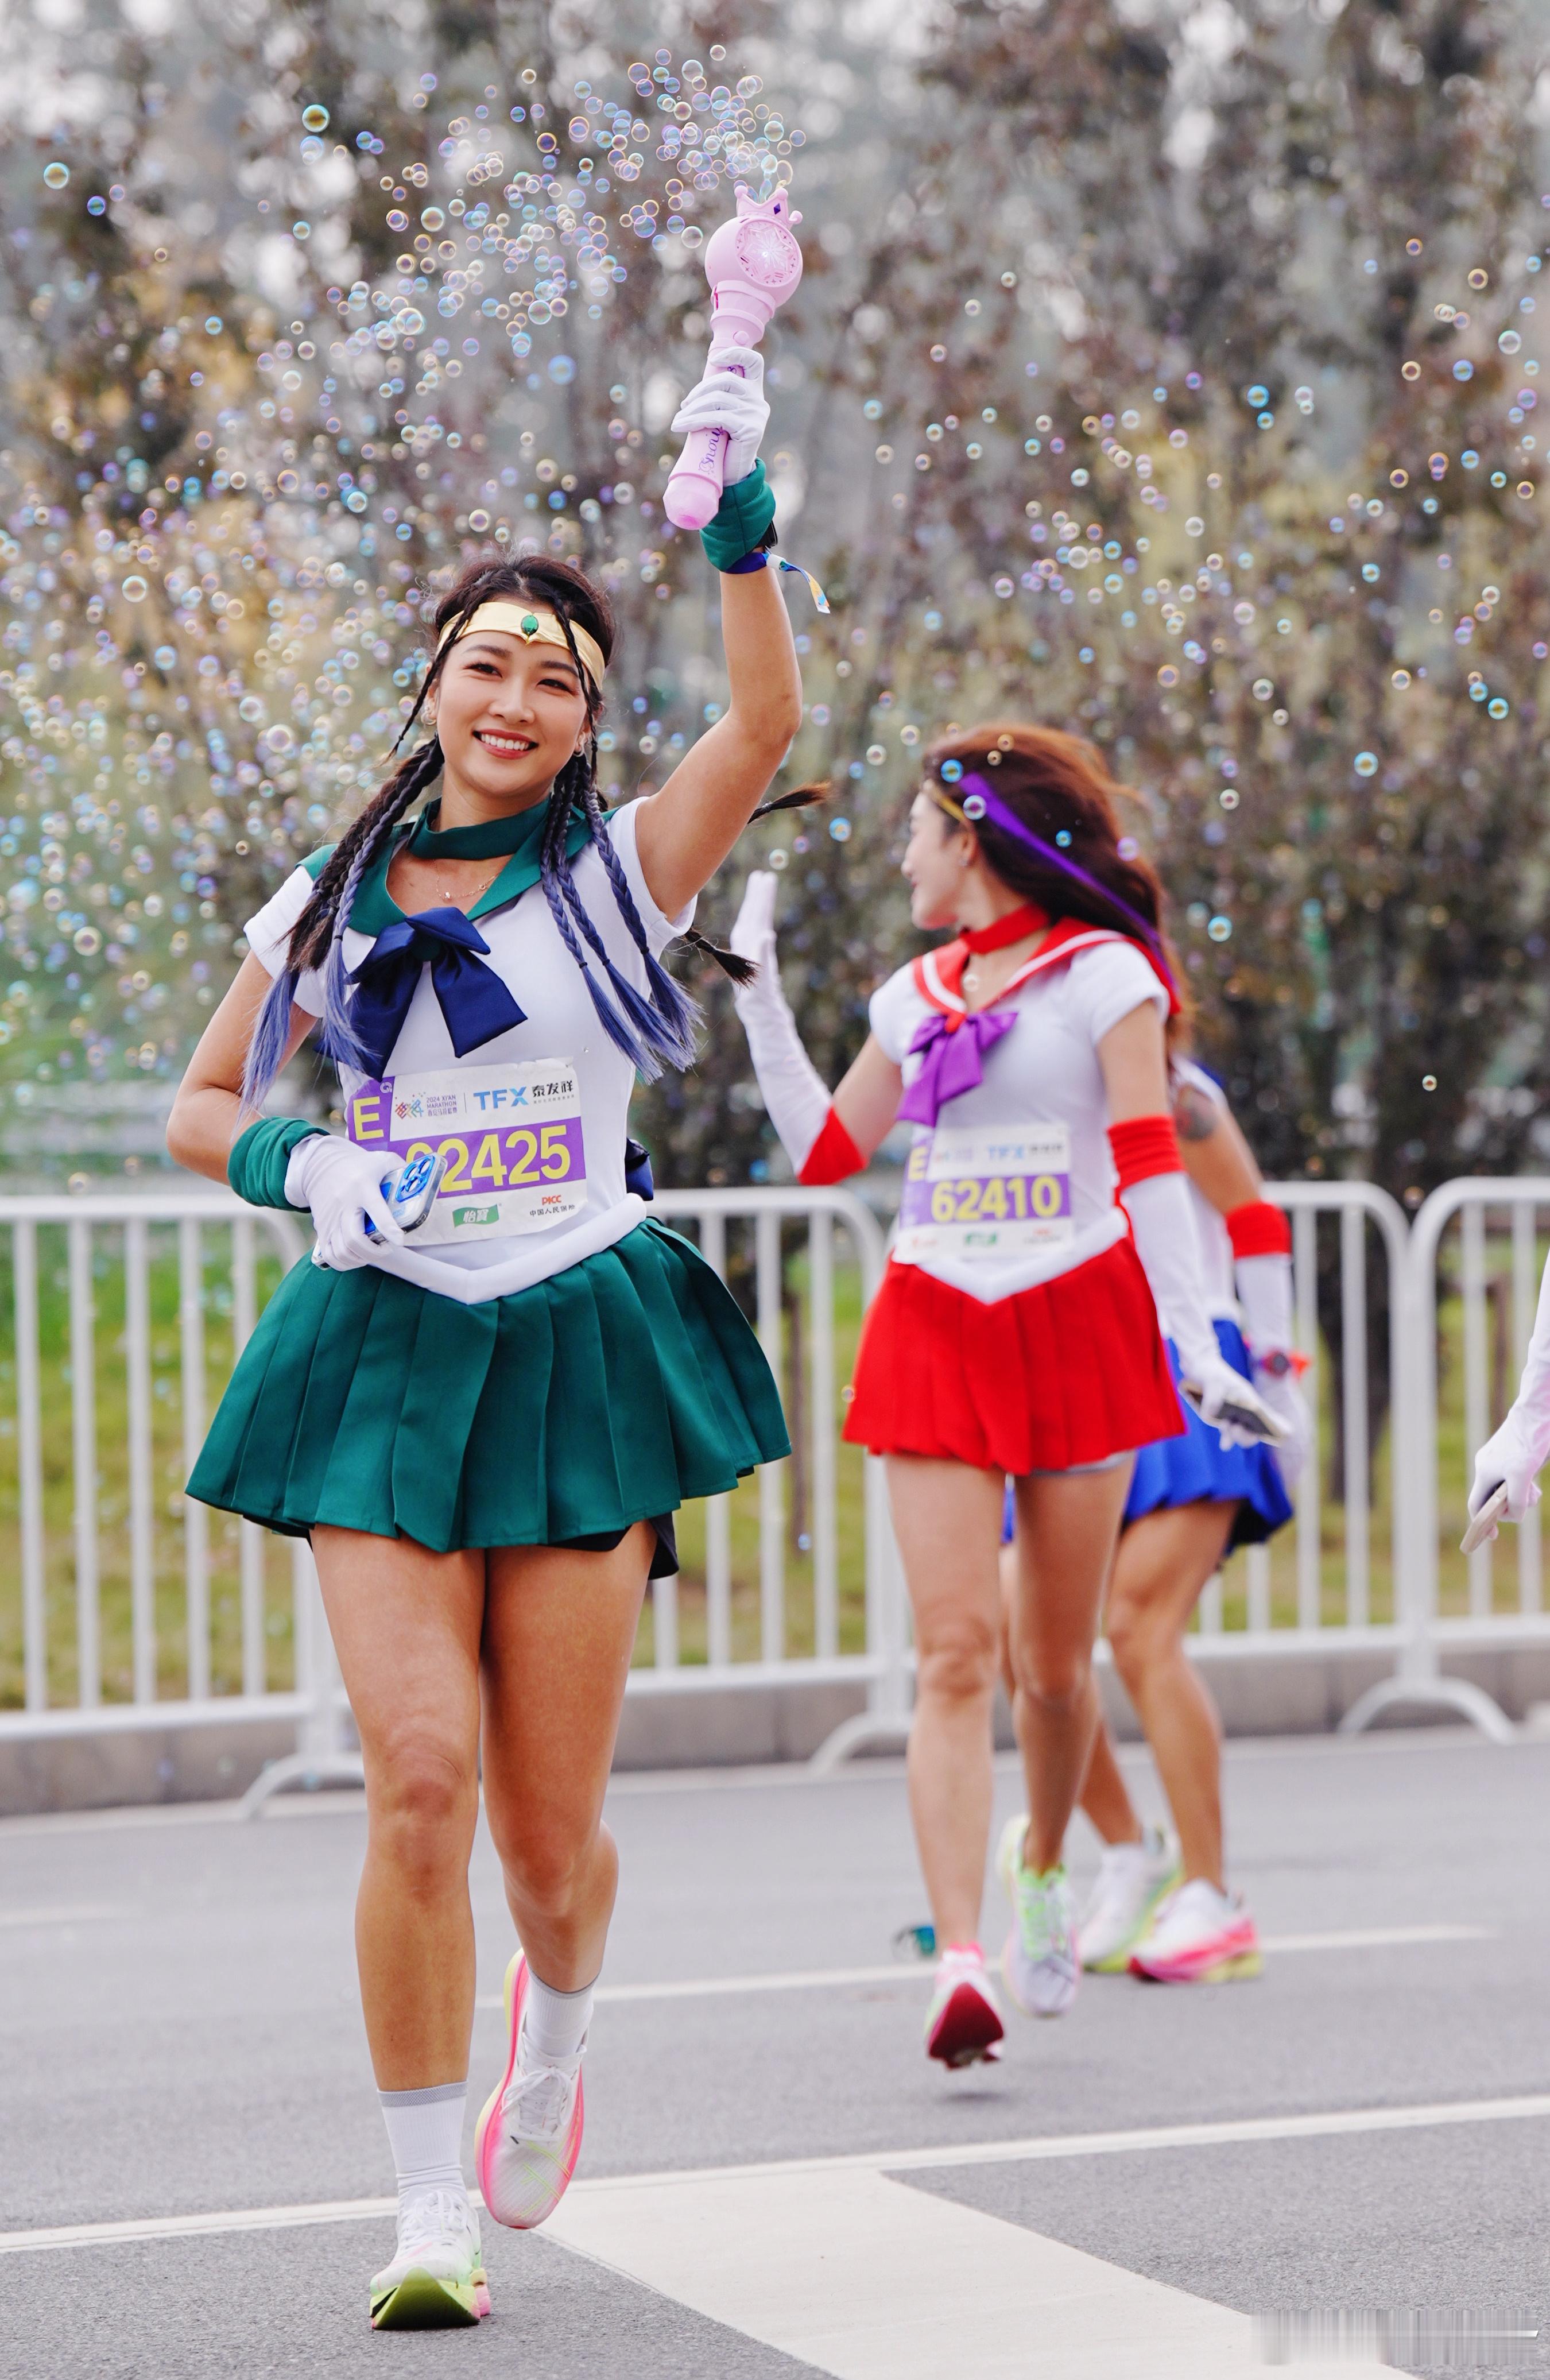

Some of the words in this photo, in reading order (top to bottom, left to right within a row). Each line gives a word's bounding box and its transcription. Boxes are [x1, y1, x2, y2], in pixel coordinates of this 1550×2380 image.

[473, 1086, 529, 1110] TFX
[532, 1080, 574, 1098] 泰发祥
[353, 1096, 384, 1141] E
[908, 1146, 927, 1181] E
[541, 1195, 562, 1205] PICC
[931, 1175, 1062, 1222] 62410
[529, 1205, 575, 1217] 中国人民保险
